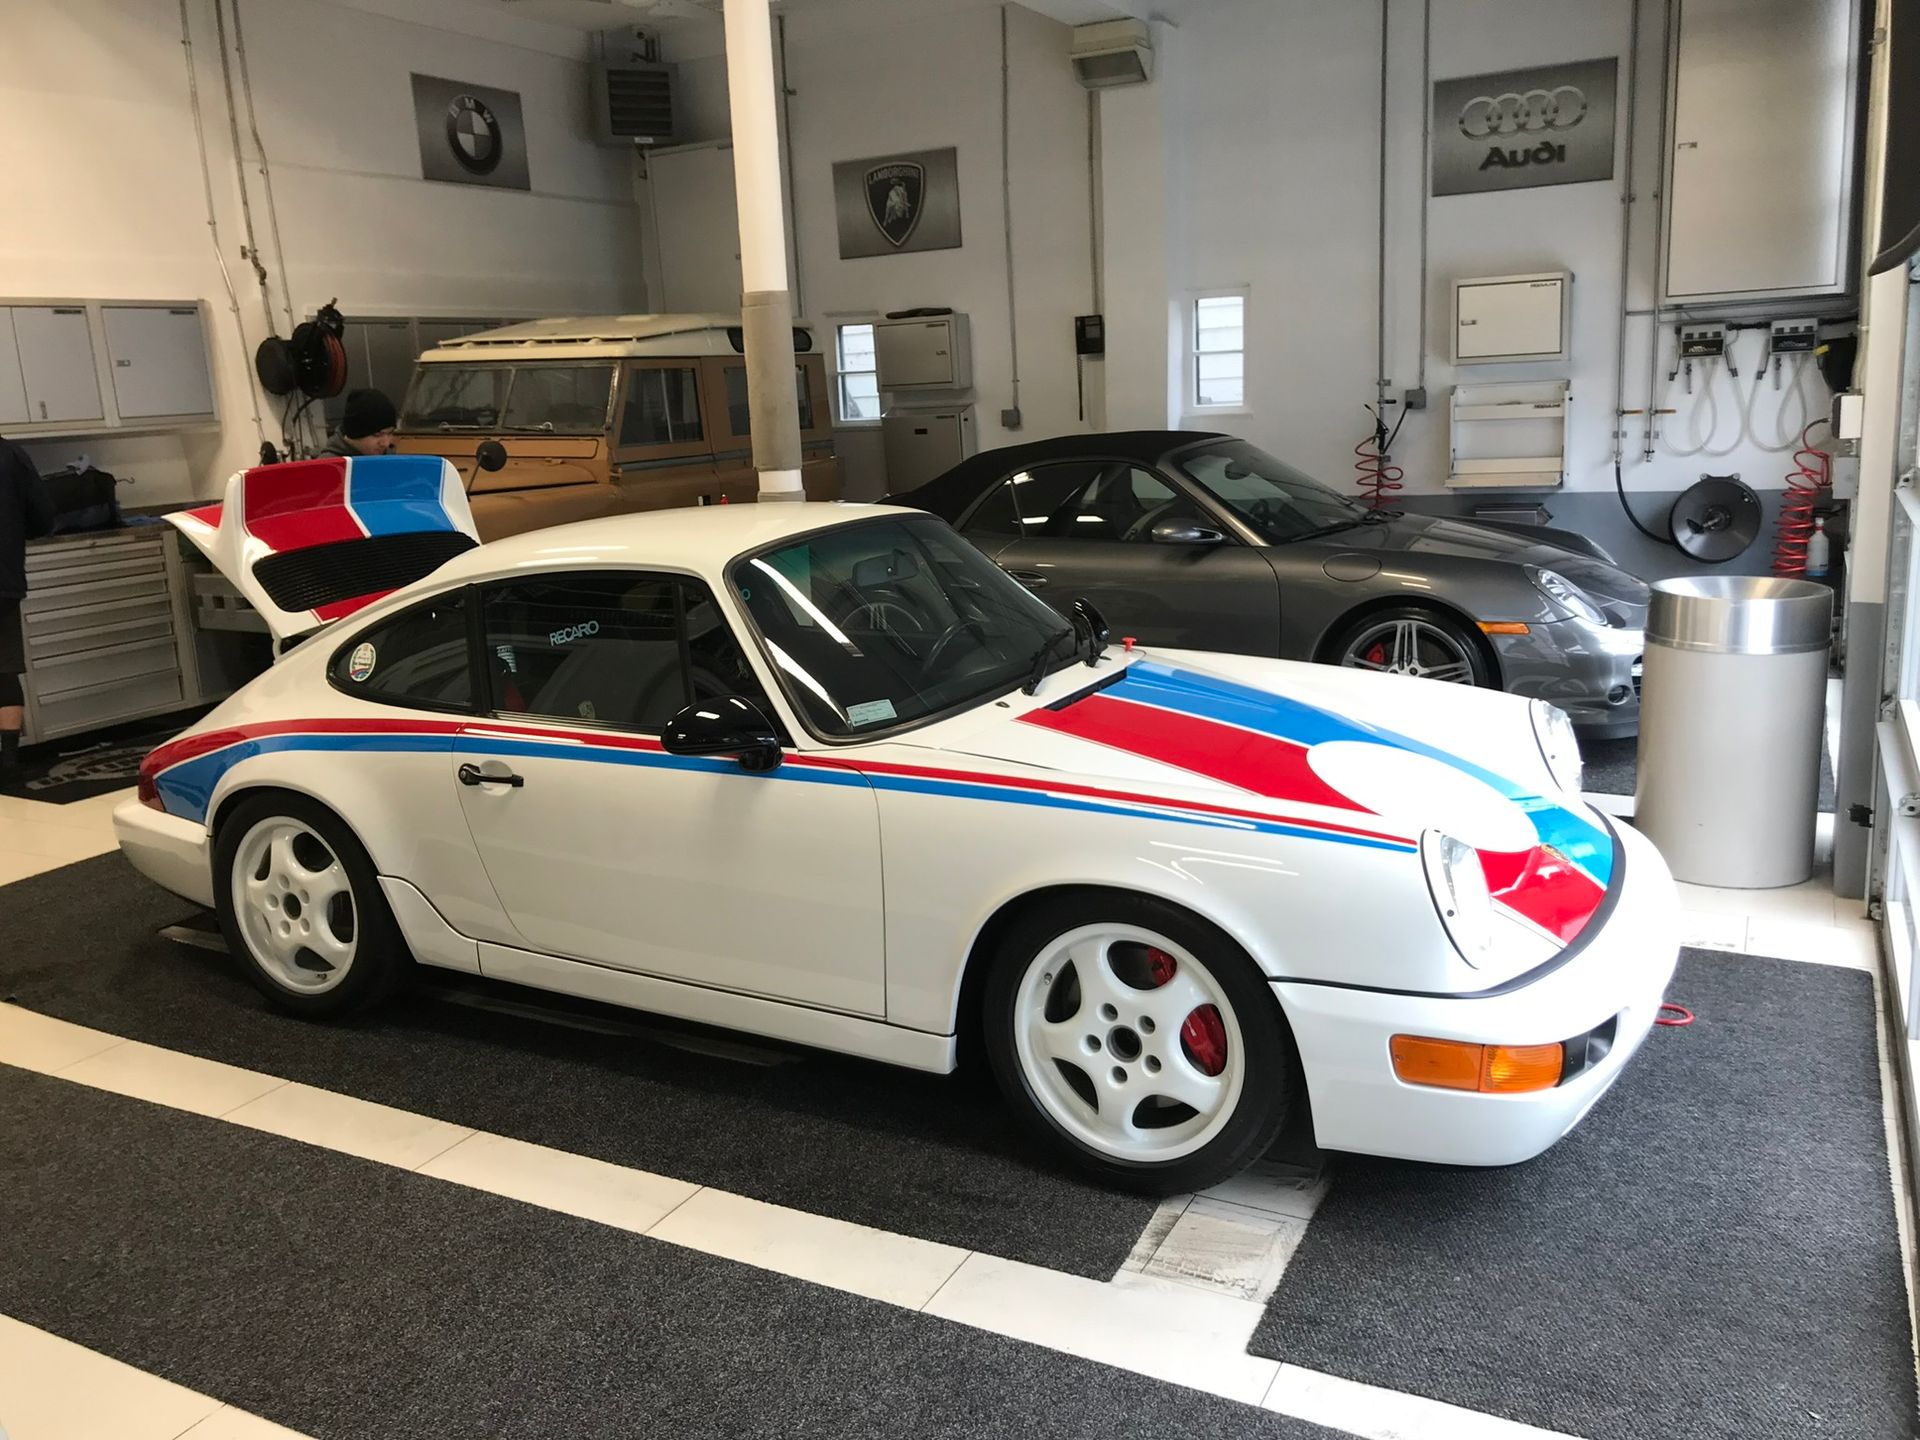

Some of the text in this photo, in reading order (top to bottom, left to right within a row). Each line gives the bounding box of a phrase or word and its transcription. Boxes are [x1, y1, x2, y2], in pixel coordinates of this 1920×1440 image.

[449, 97, 494, 123] BMW
[1479, 141, 1566, 171] Audi
[549, 620, 600, 647] RECARO
